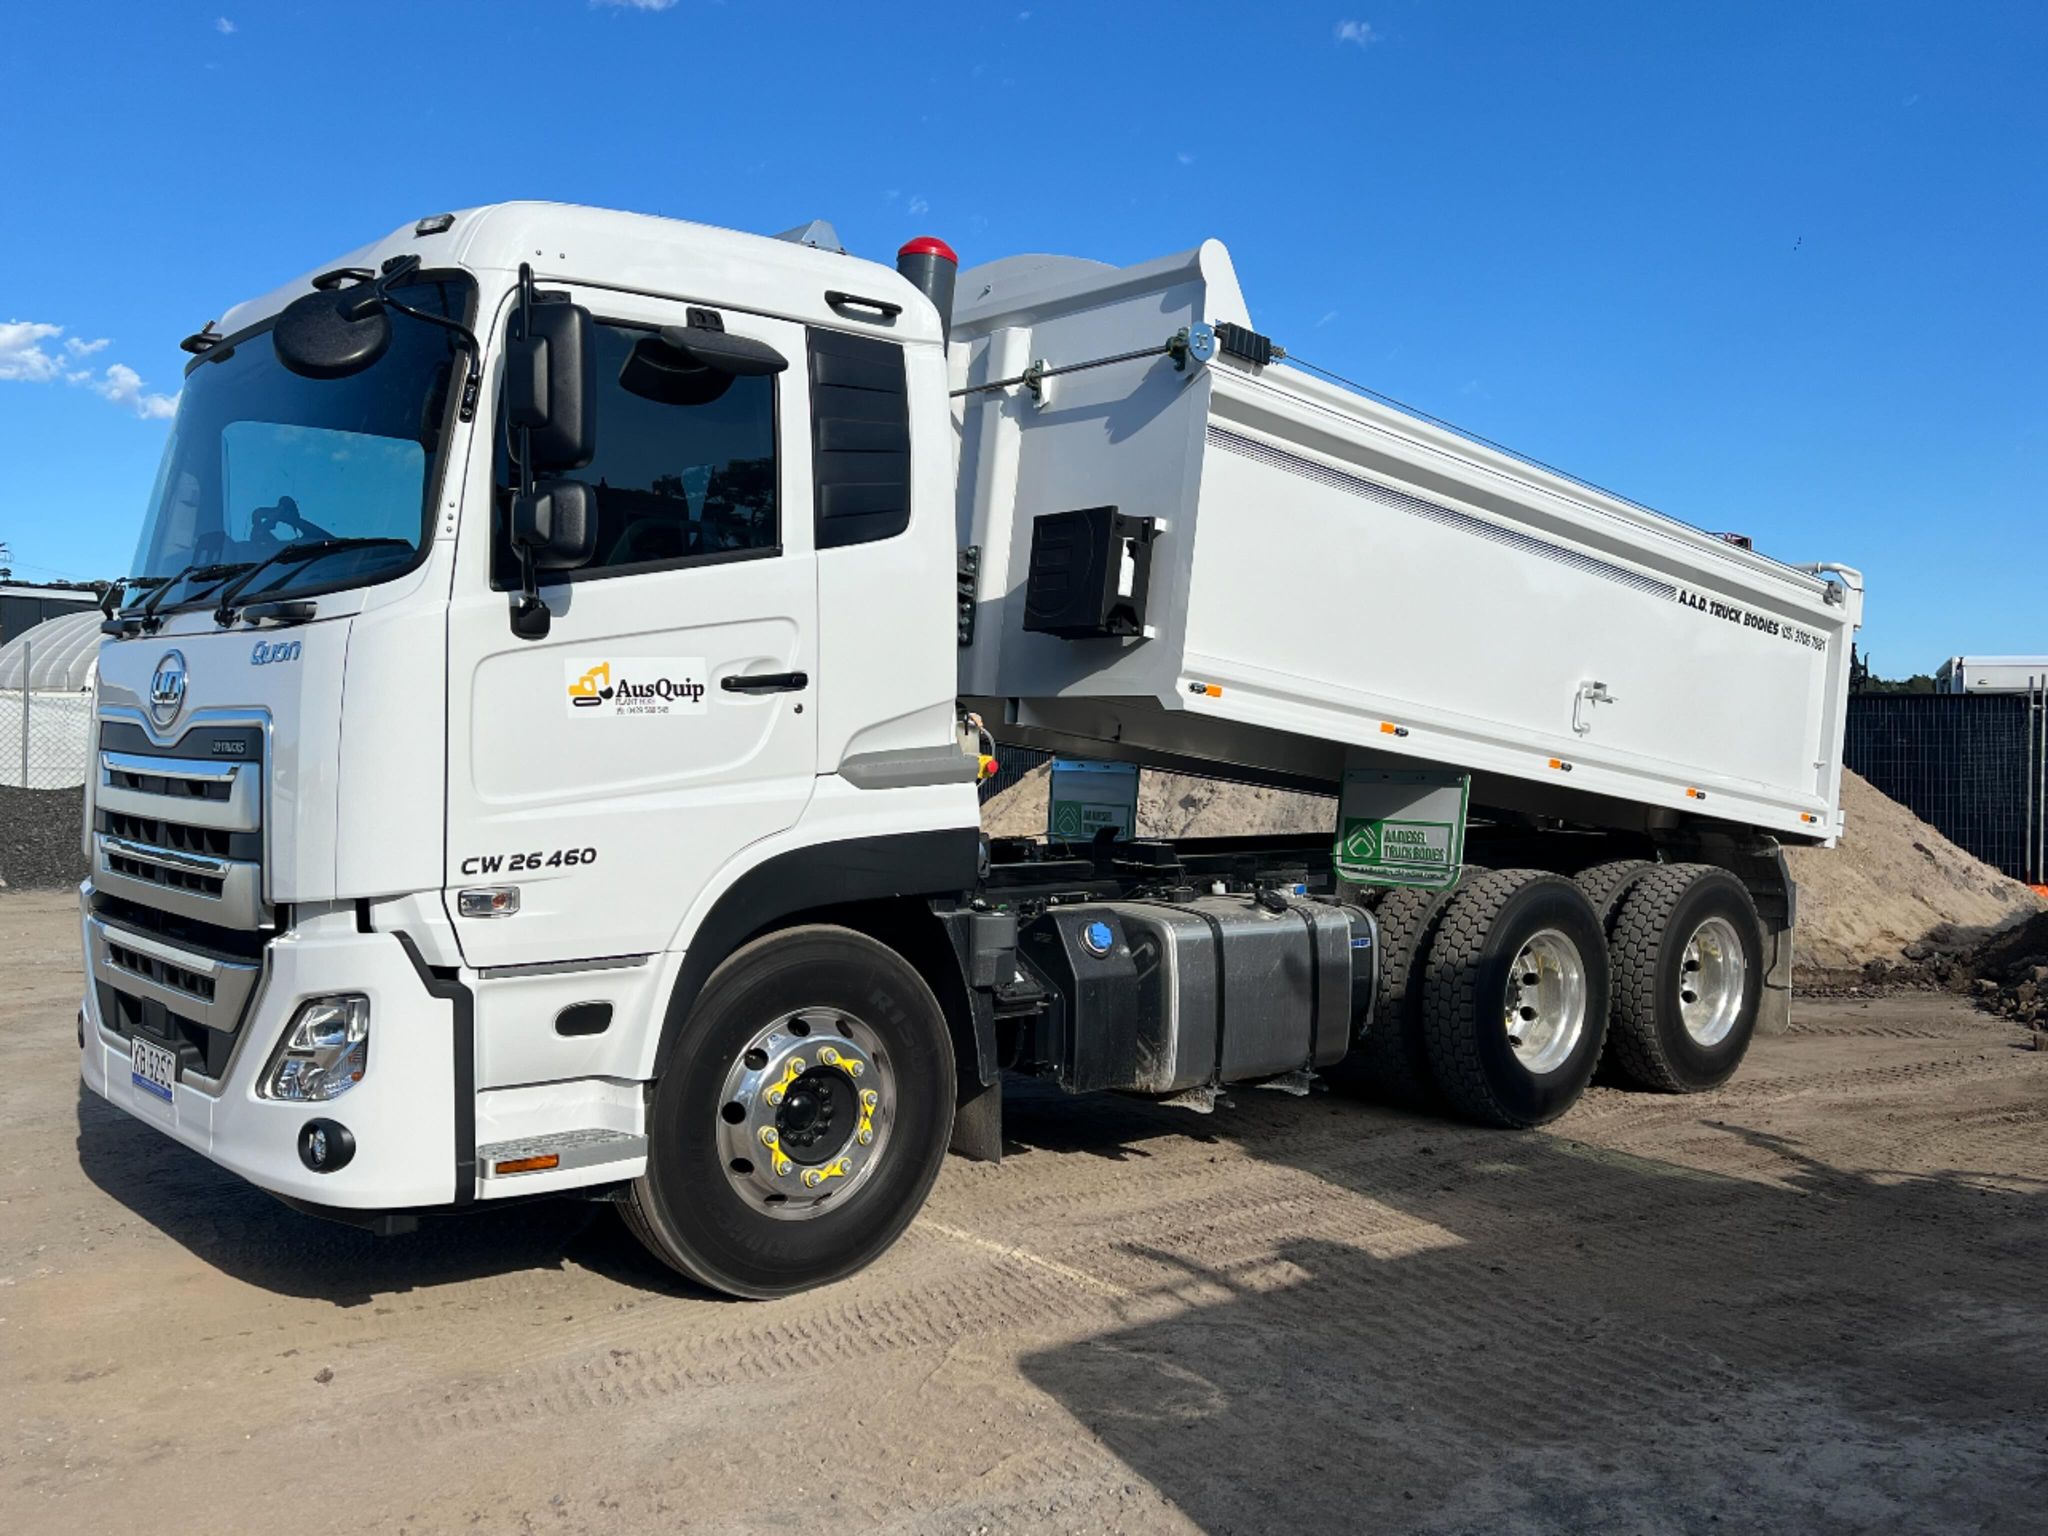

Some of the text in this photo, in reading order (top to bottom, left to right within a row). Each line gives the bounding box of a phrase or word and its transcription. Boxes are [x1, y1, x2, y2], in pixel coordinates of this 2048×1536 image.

[1709, 601, 1742, 625] TRUCK
[1743, 611, 1779, 636] BODIES
[615, 677, 705, 703] AusQuip
[461, 847, 597, 876] CW 26 460
[1384, 845, 1445, 861] TRUCK BODIES
